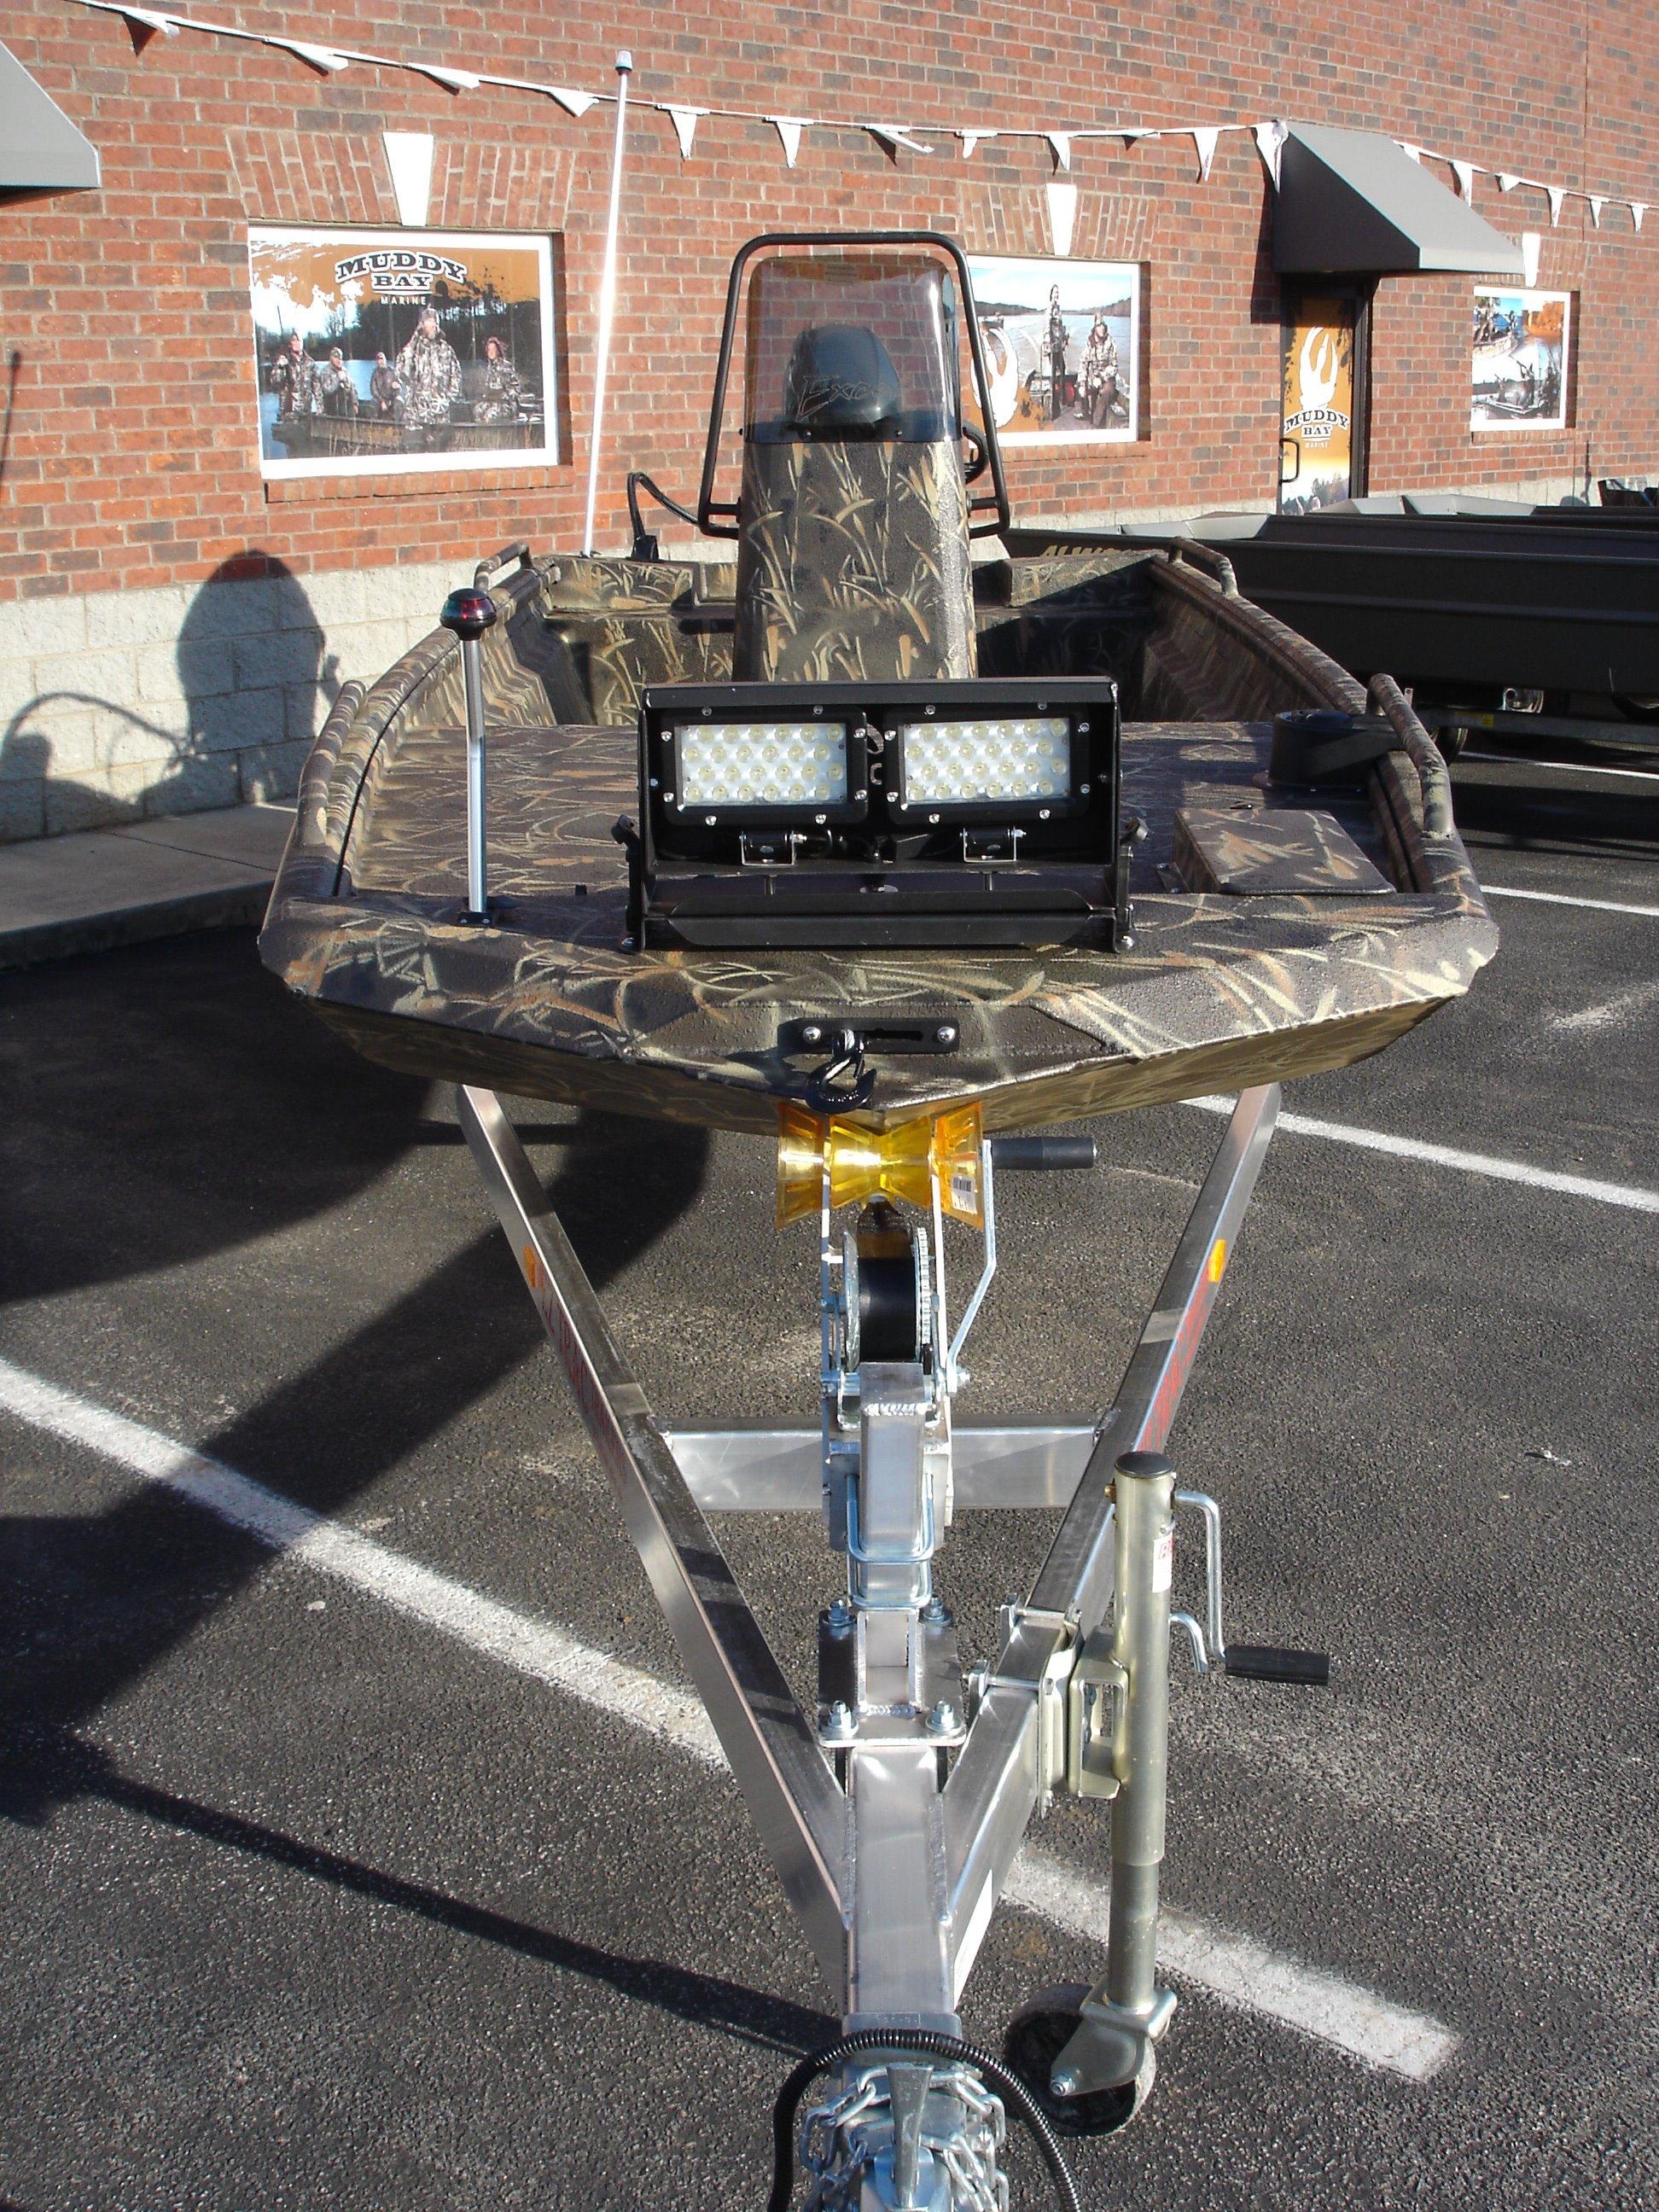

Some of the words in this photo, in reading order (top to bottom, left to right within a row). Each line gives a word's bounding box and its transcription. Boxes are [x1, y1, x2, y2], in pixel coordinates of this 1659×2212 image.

[336, 252, 465, 281] MUDDY
[373, 275, 431, 287] BAY
[380, 295, 427, 306] MARINE
[1285, 410, 1348, 432] MUDDY
[1303, 426, 1331, 435] BAY
